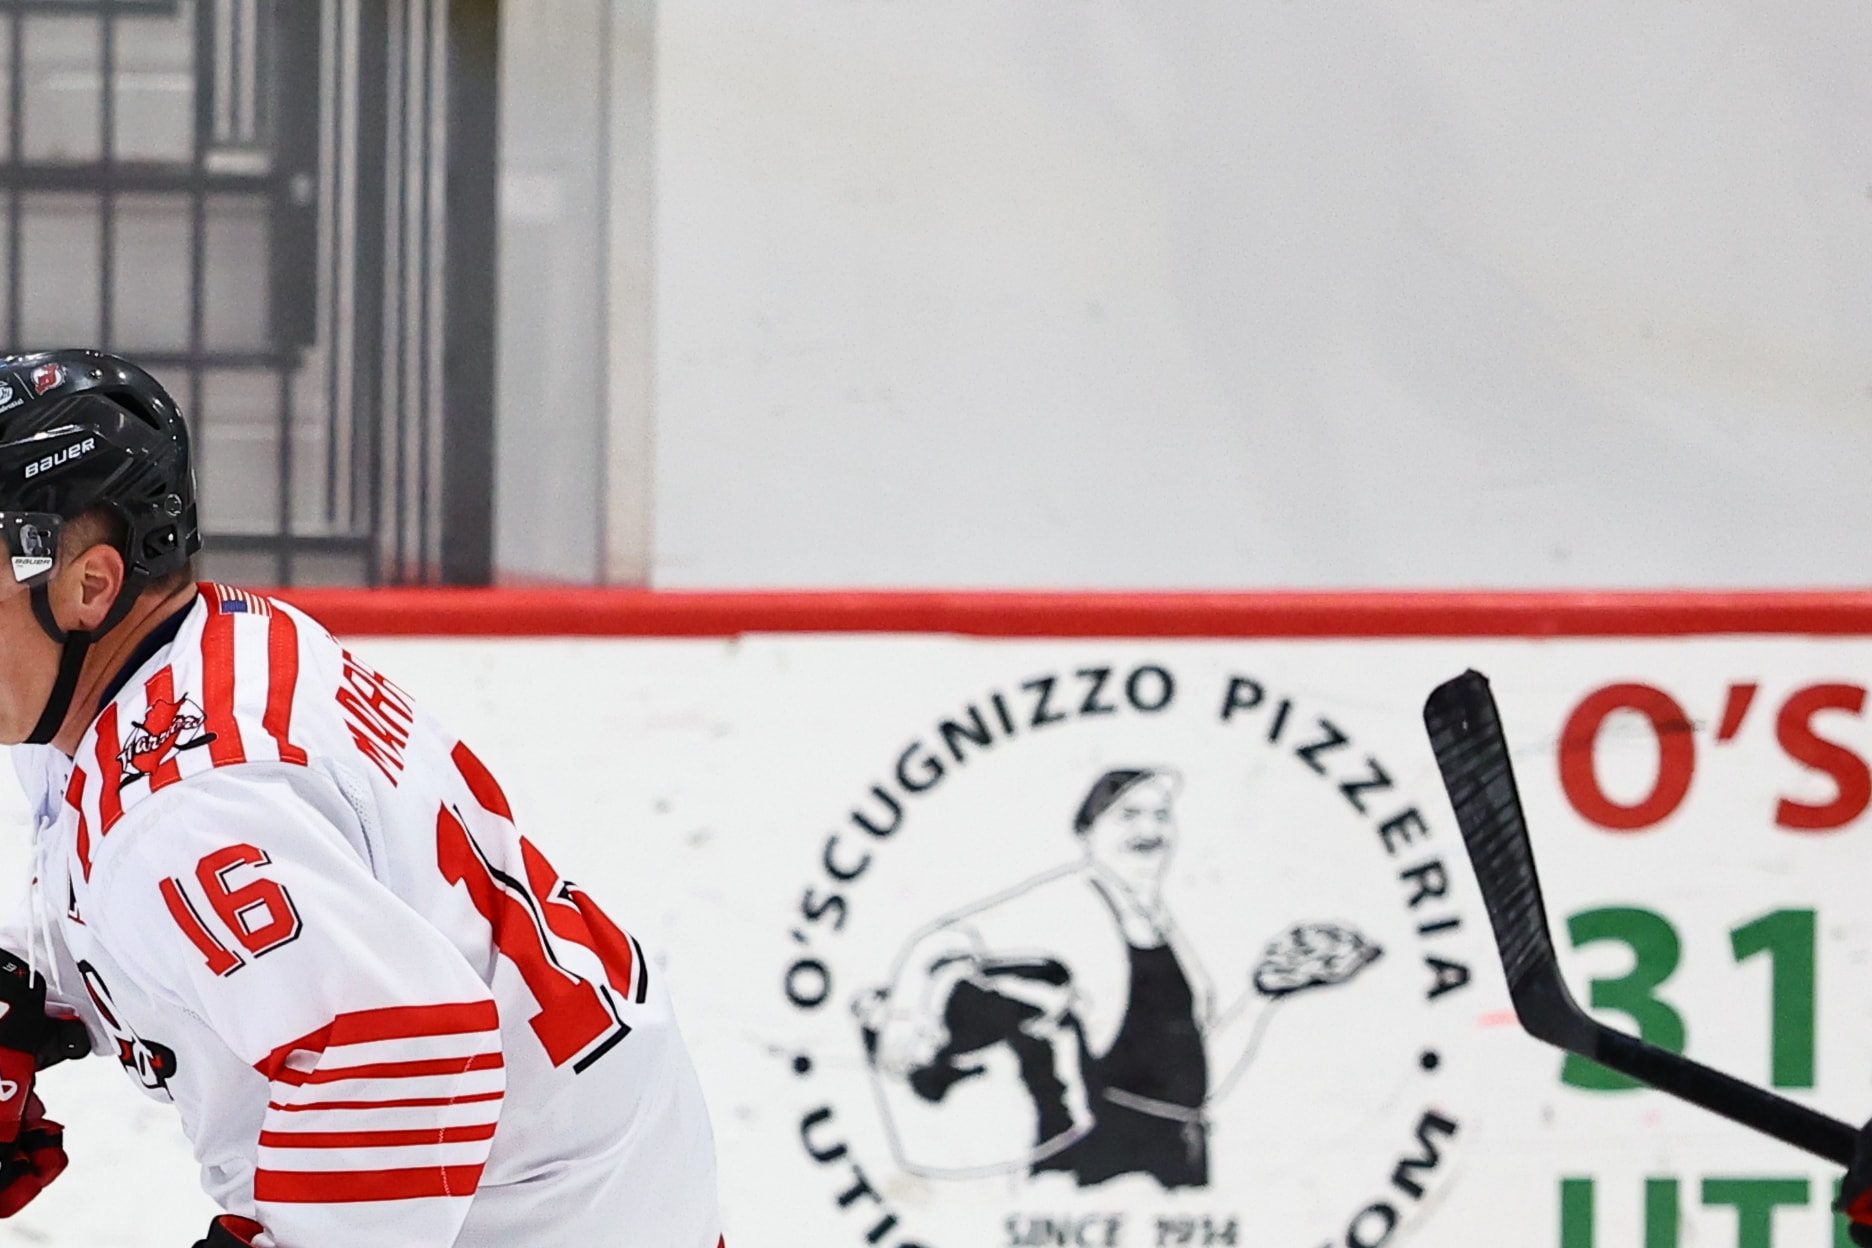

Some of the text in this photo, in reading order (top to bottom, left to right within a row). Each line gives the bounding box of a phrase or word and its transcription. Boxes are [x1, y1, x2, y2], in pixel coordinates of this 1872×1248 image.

[24, 436, 96, 479] BAUER
[157, 842, 303, 978] 16
[783, 664, 1472, 1010] O'SCUGNIZZO PIZZERIA
[1560, 905, 1819, 1092] 31
